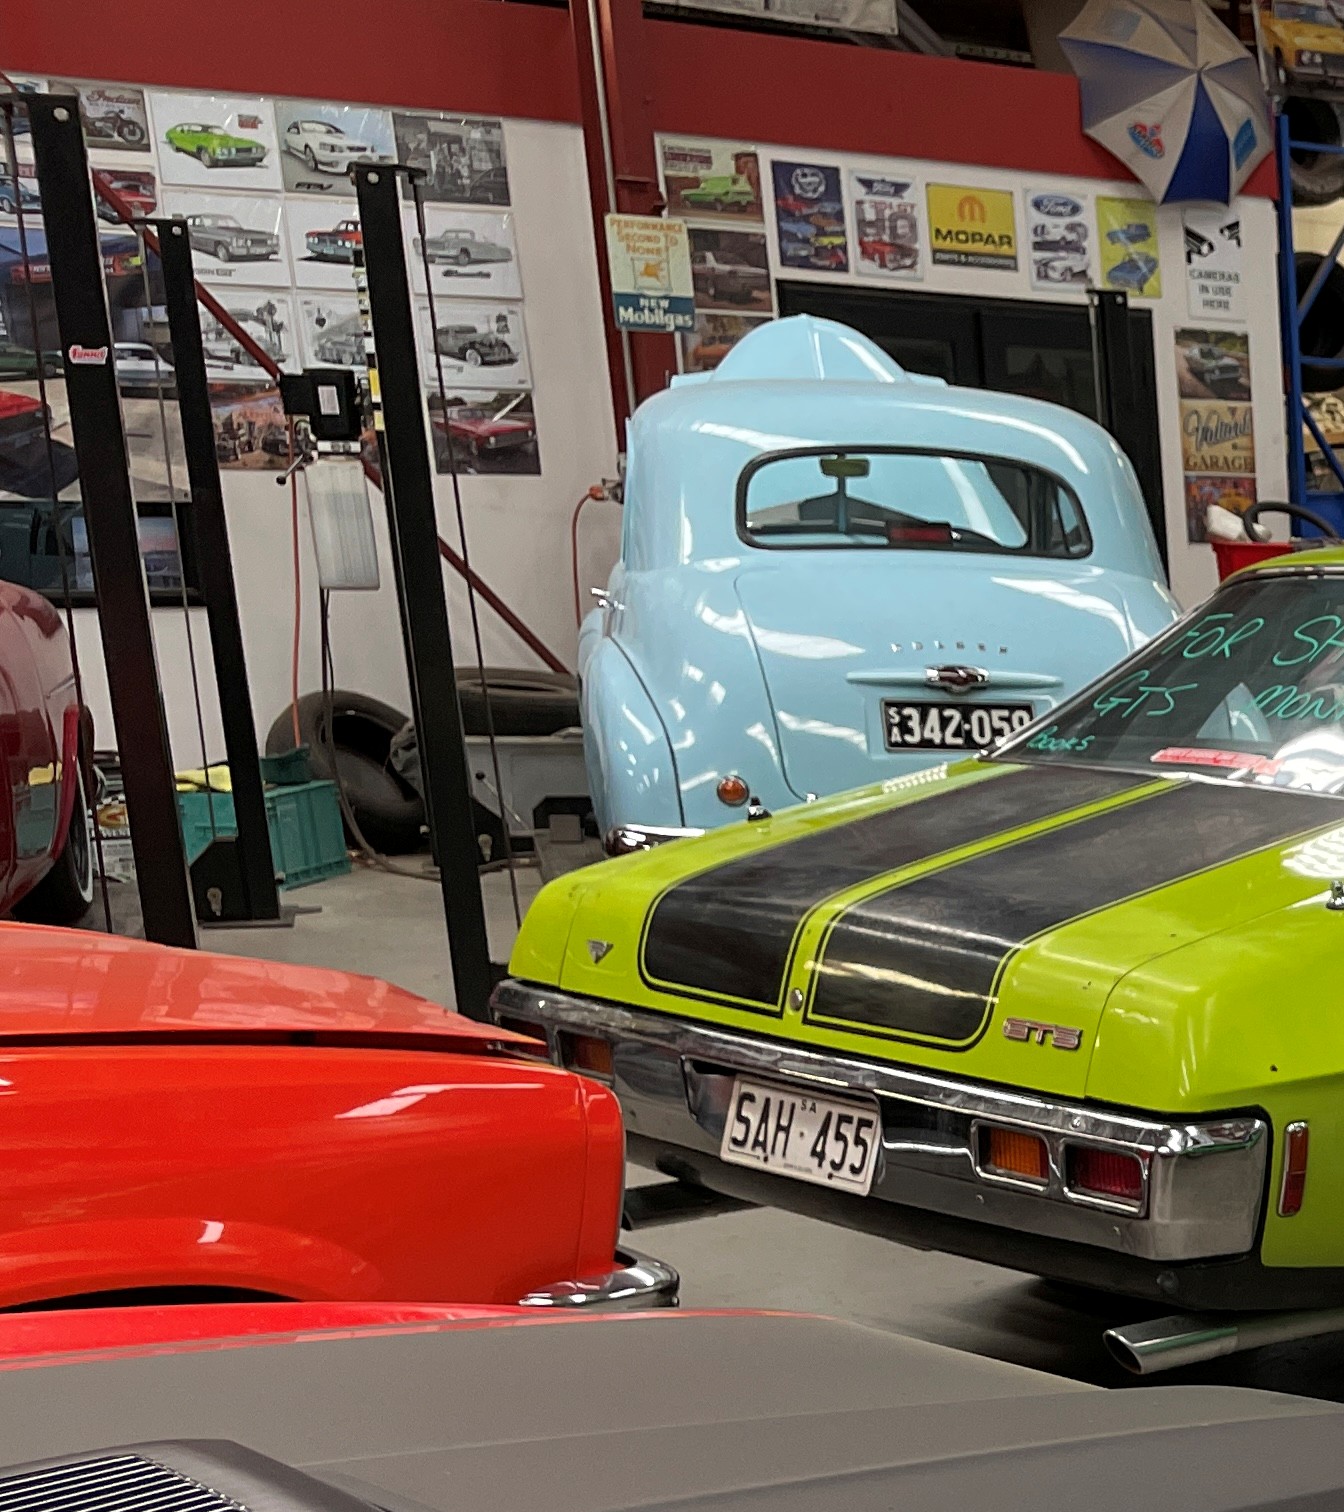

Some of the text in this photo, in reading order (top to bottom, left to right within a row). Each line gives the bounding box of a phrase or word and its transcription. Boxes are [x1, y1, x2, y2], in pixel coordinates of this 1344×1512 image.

[935, 227, 1013, 249] MOPAR
[619, 305, 693, 332] Mobilgas
[1162, 613, 1264, 658] FOR
[1094, 670, 1198, 718] GTS
[1003, 1017, 1082, 1050] GTS
[801, 1099, 817, 1114] SA
